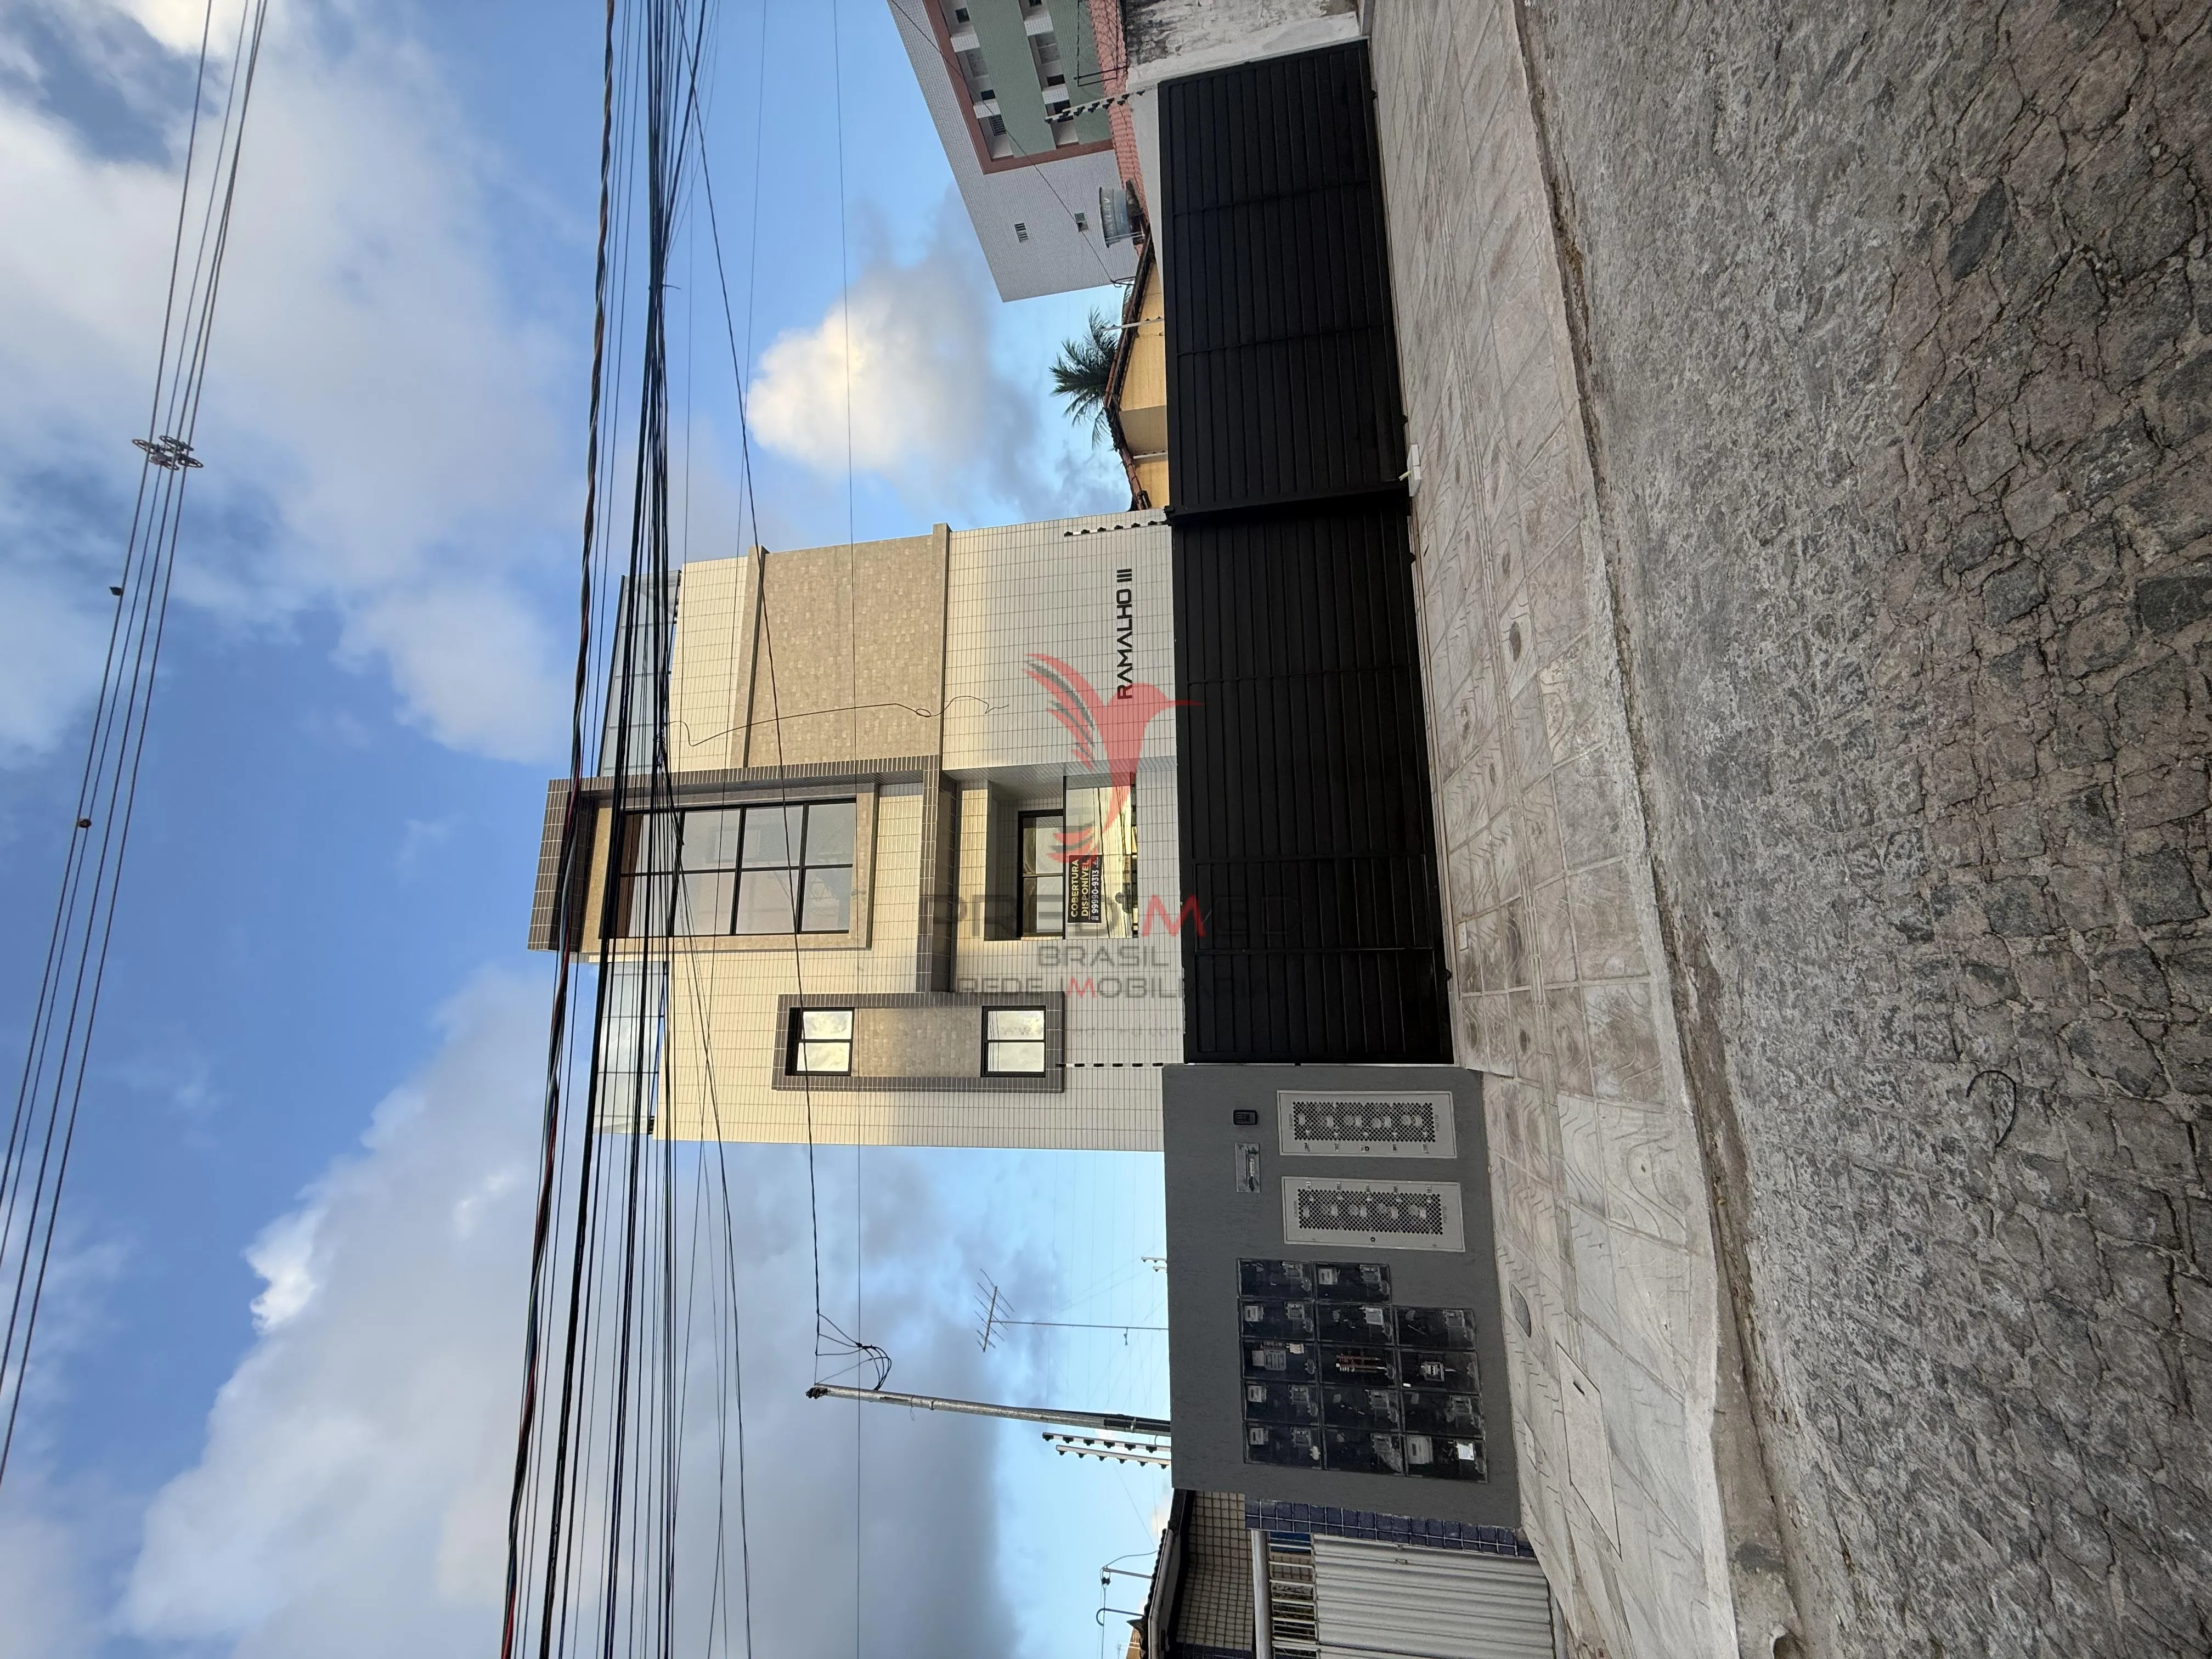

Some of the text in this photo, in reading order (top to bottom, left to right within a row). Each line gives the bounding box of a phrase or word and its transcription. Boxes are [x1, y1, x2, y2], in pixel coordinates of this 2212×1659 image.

[1116, 568, 1133, 699] RAMALHO III
[1070, 859, 1079, 918] COBERTURA
[1080, 859, 1089, 917] DISPONÍVEL
[1091, 870, 1099, 914] 99990-9313
